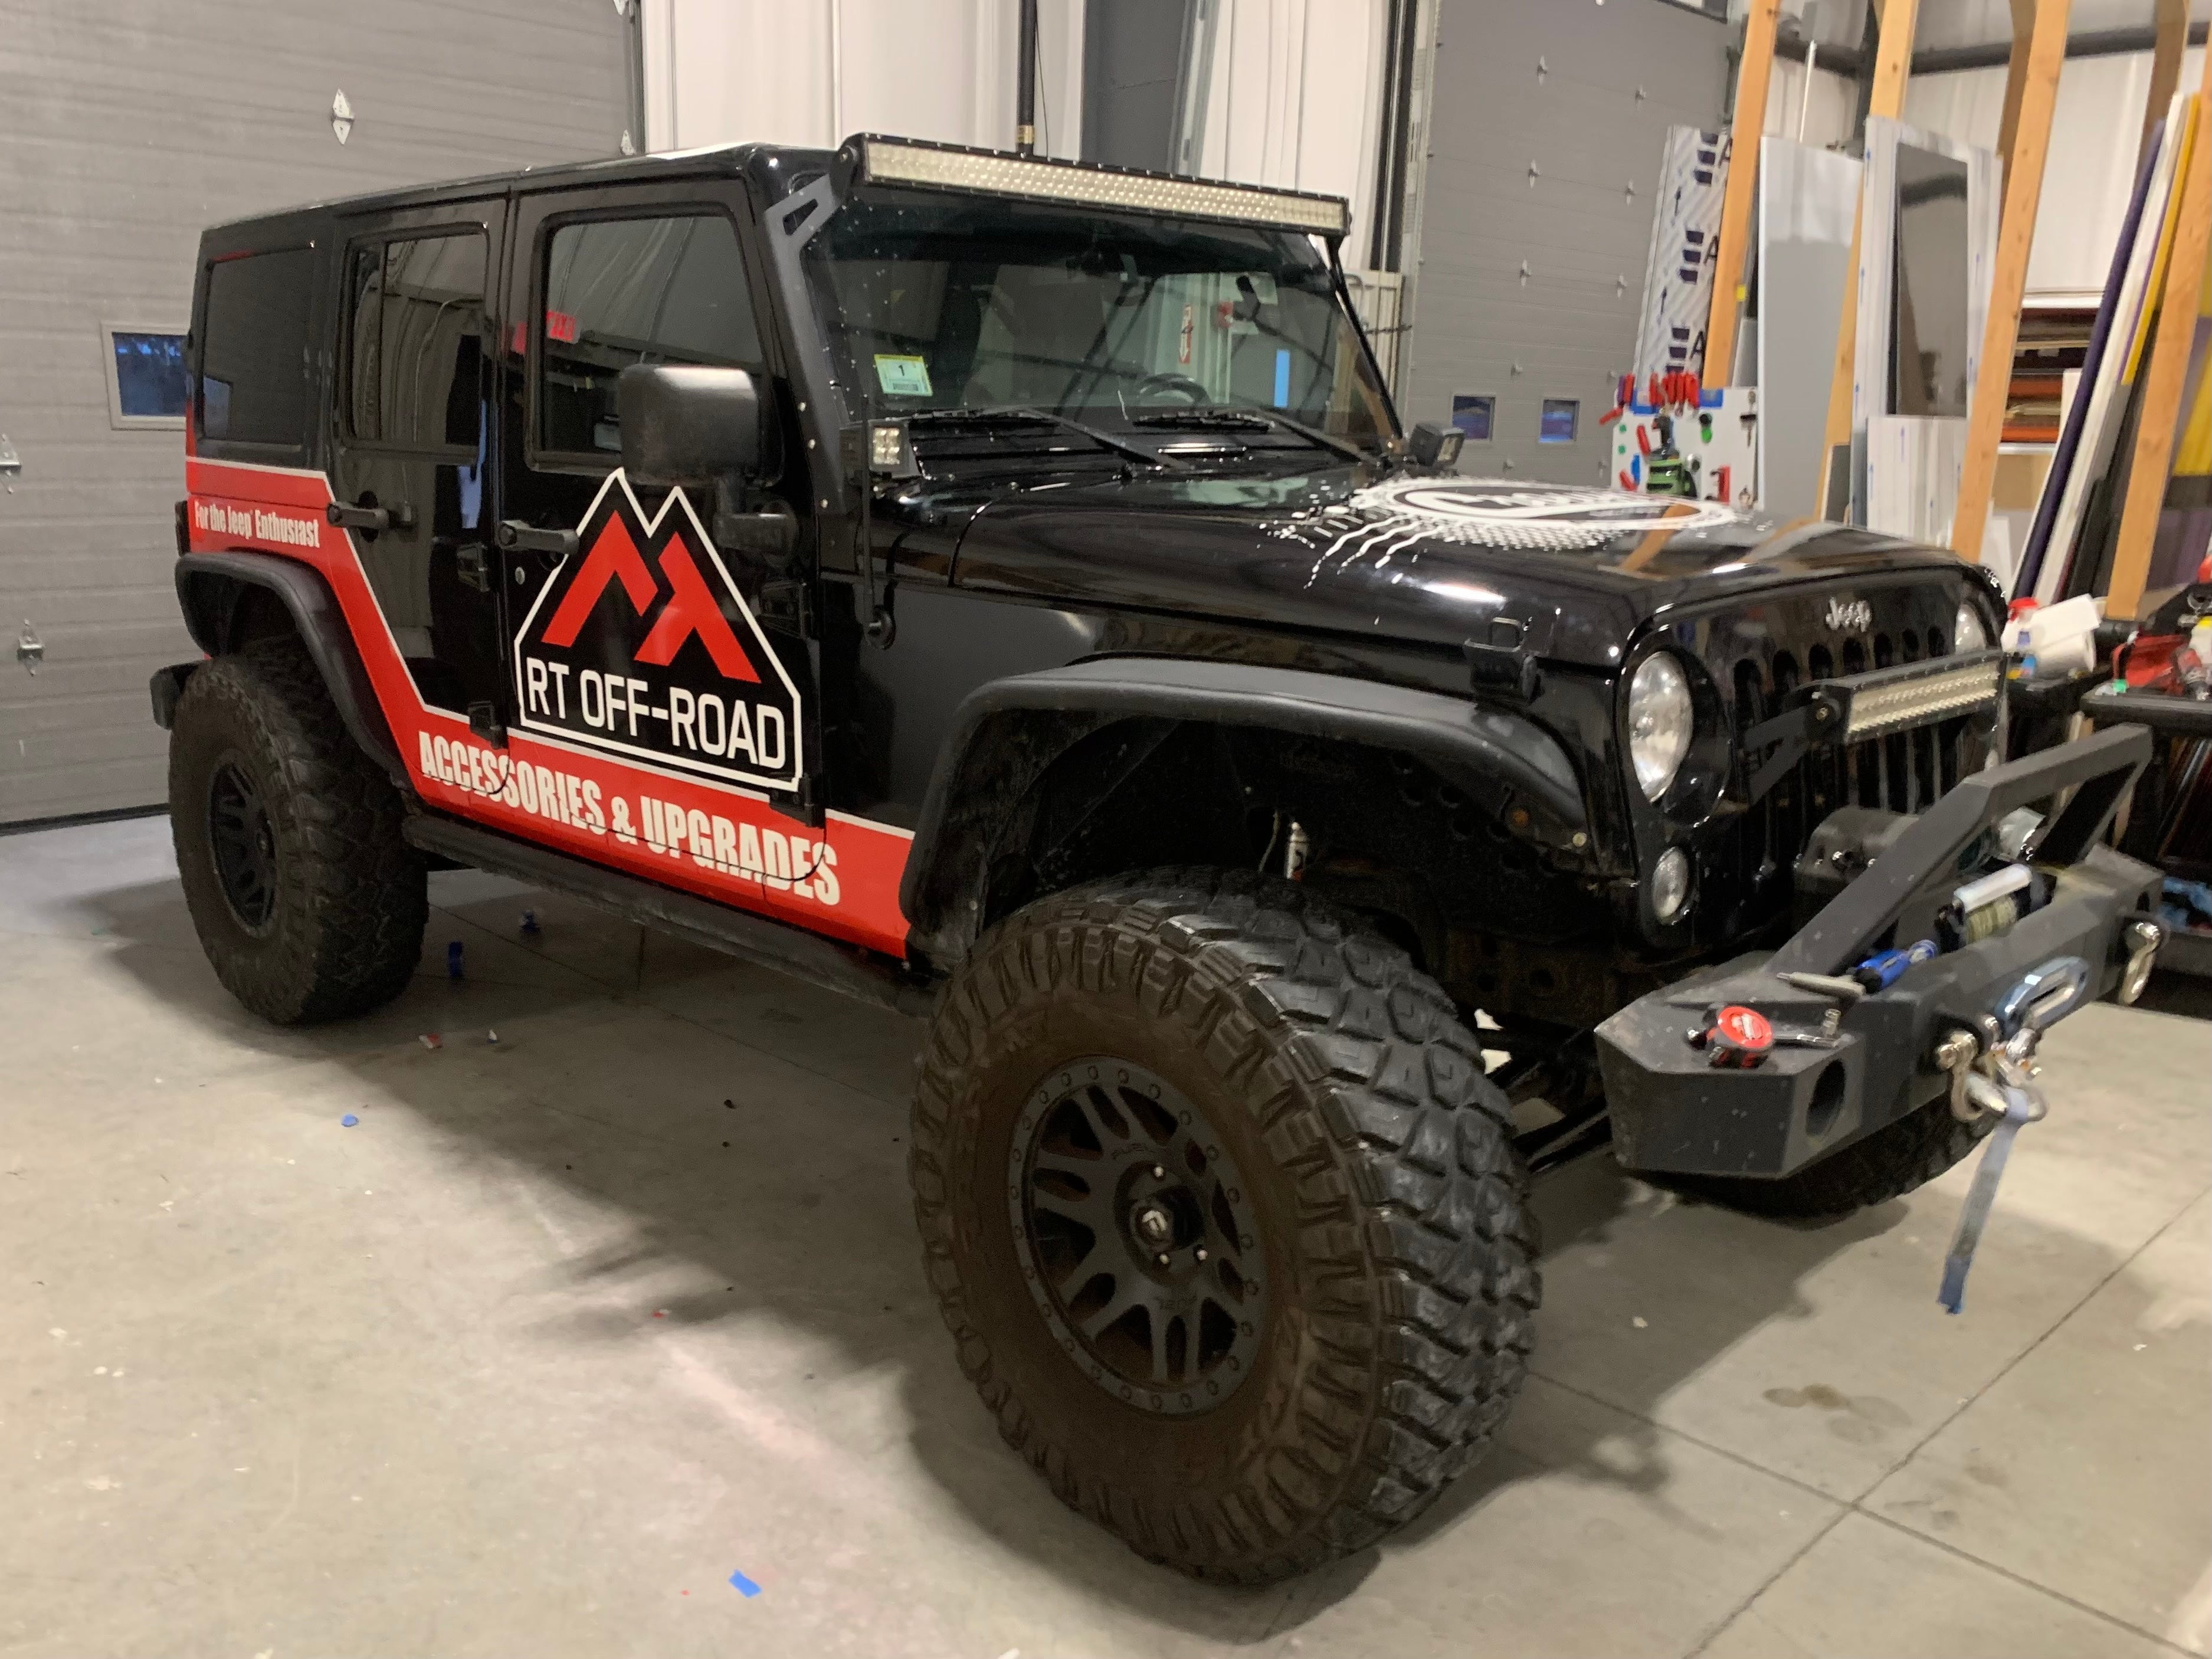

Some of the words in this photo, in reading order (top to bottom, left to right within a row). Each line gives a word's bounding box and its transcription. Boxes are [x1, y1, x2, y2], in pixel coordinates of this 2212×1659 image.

[898, 365, 905, 376] 1
[195, 501, 209, 530] For
[209, 503, 226, 533] the
[255, 509, 320, 548] Enthusiast
[1826, 596, 1872, 632] Jeep
[526, 657, 569, 718] RT
[579, 670, 787, 769] OFF-ROAD
[418, 730, 606, 835] ACCESSORIES
[611, 796, 638, 845] &
[640, 795, 841, 906] UPGRADES
